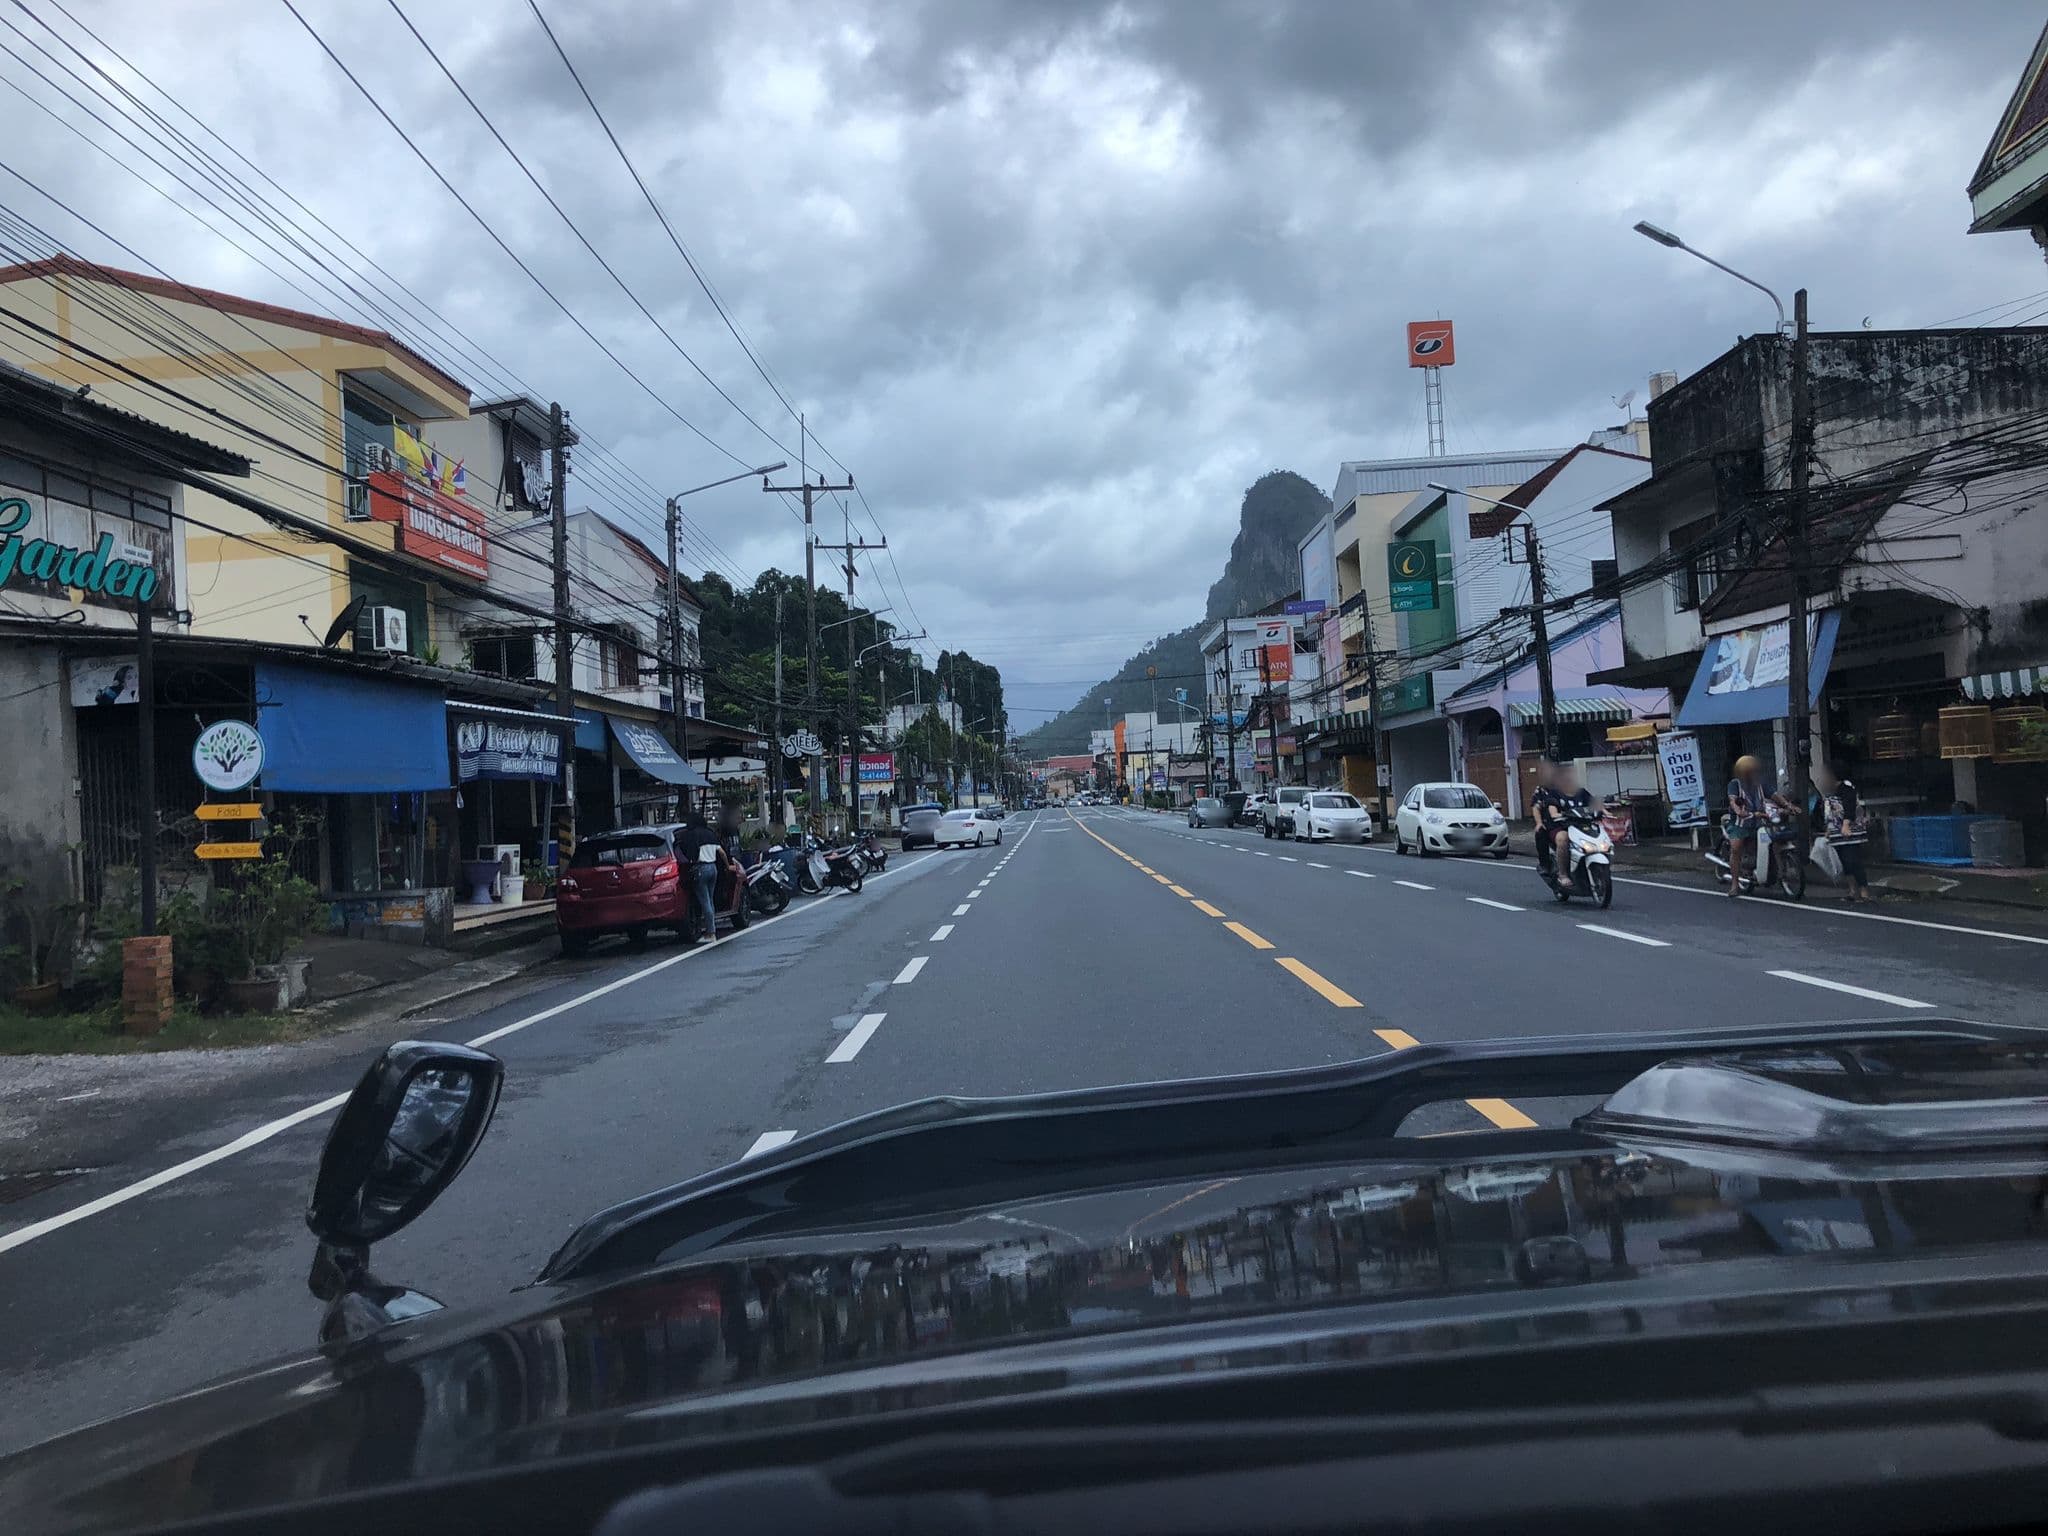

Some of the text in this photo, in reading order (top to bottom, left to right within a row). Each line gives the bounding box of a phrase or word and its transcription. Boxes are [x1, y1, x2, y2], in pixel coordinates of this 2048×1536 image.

[1270, 661, 1288, 670] ATM
[1667, 752, 1692, 766] ถ่าย
[1671, 763, 1694, 776] เอก
[1673, 774, 1697, 787] สาร
[216, 804, 241, 817] Food
